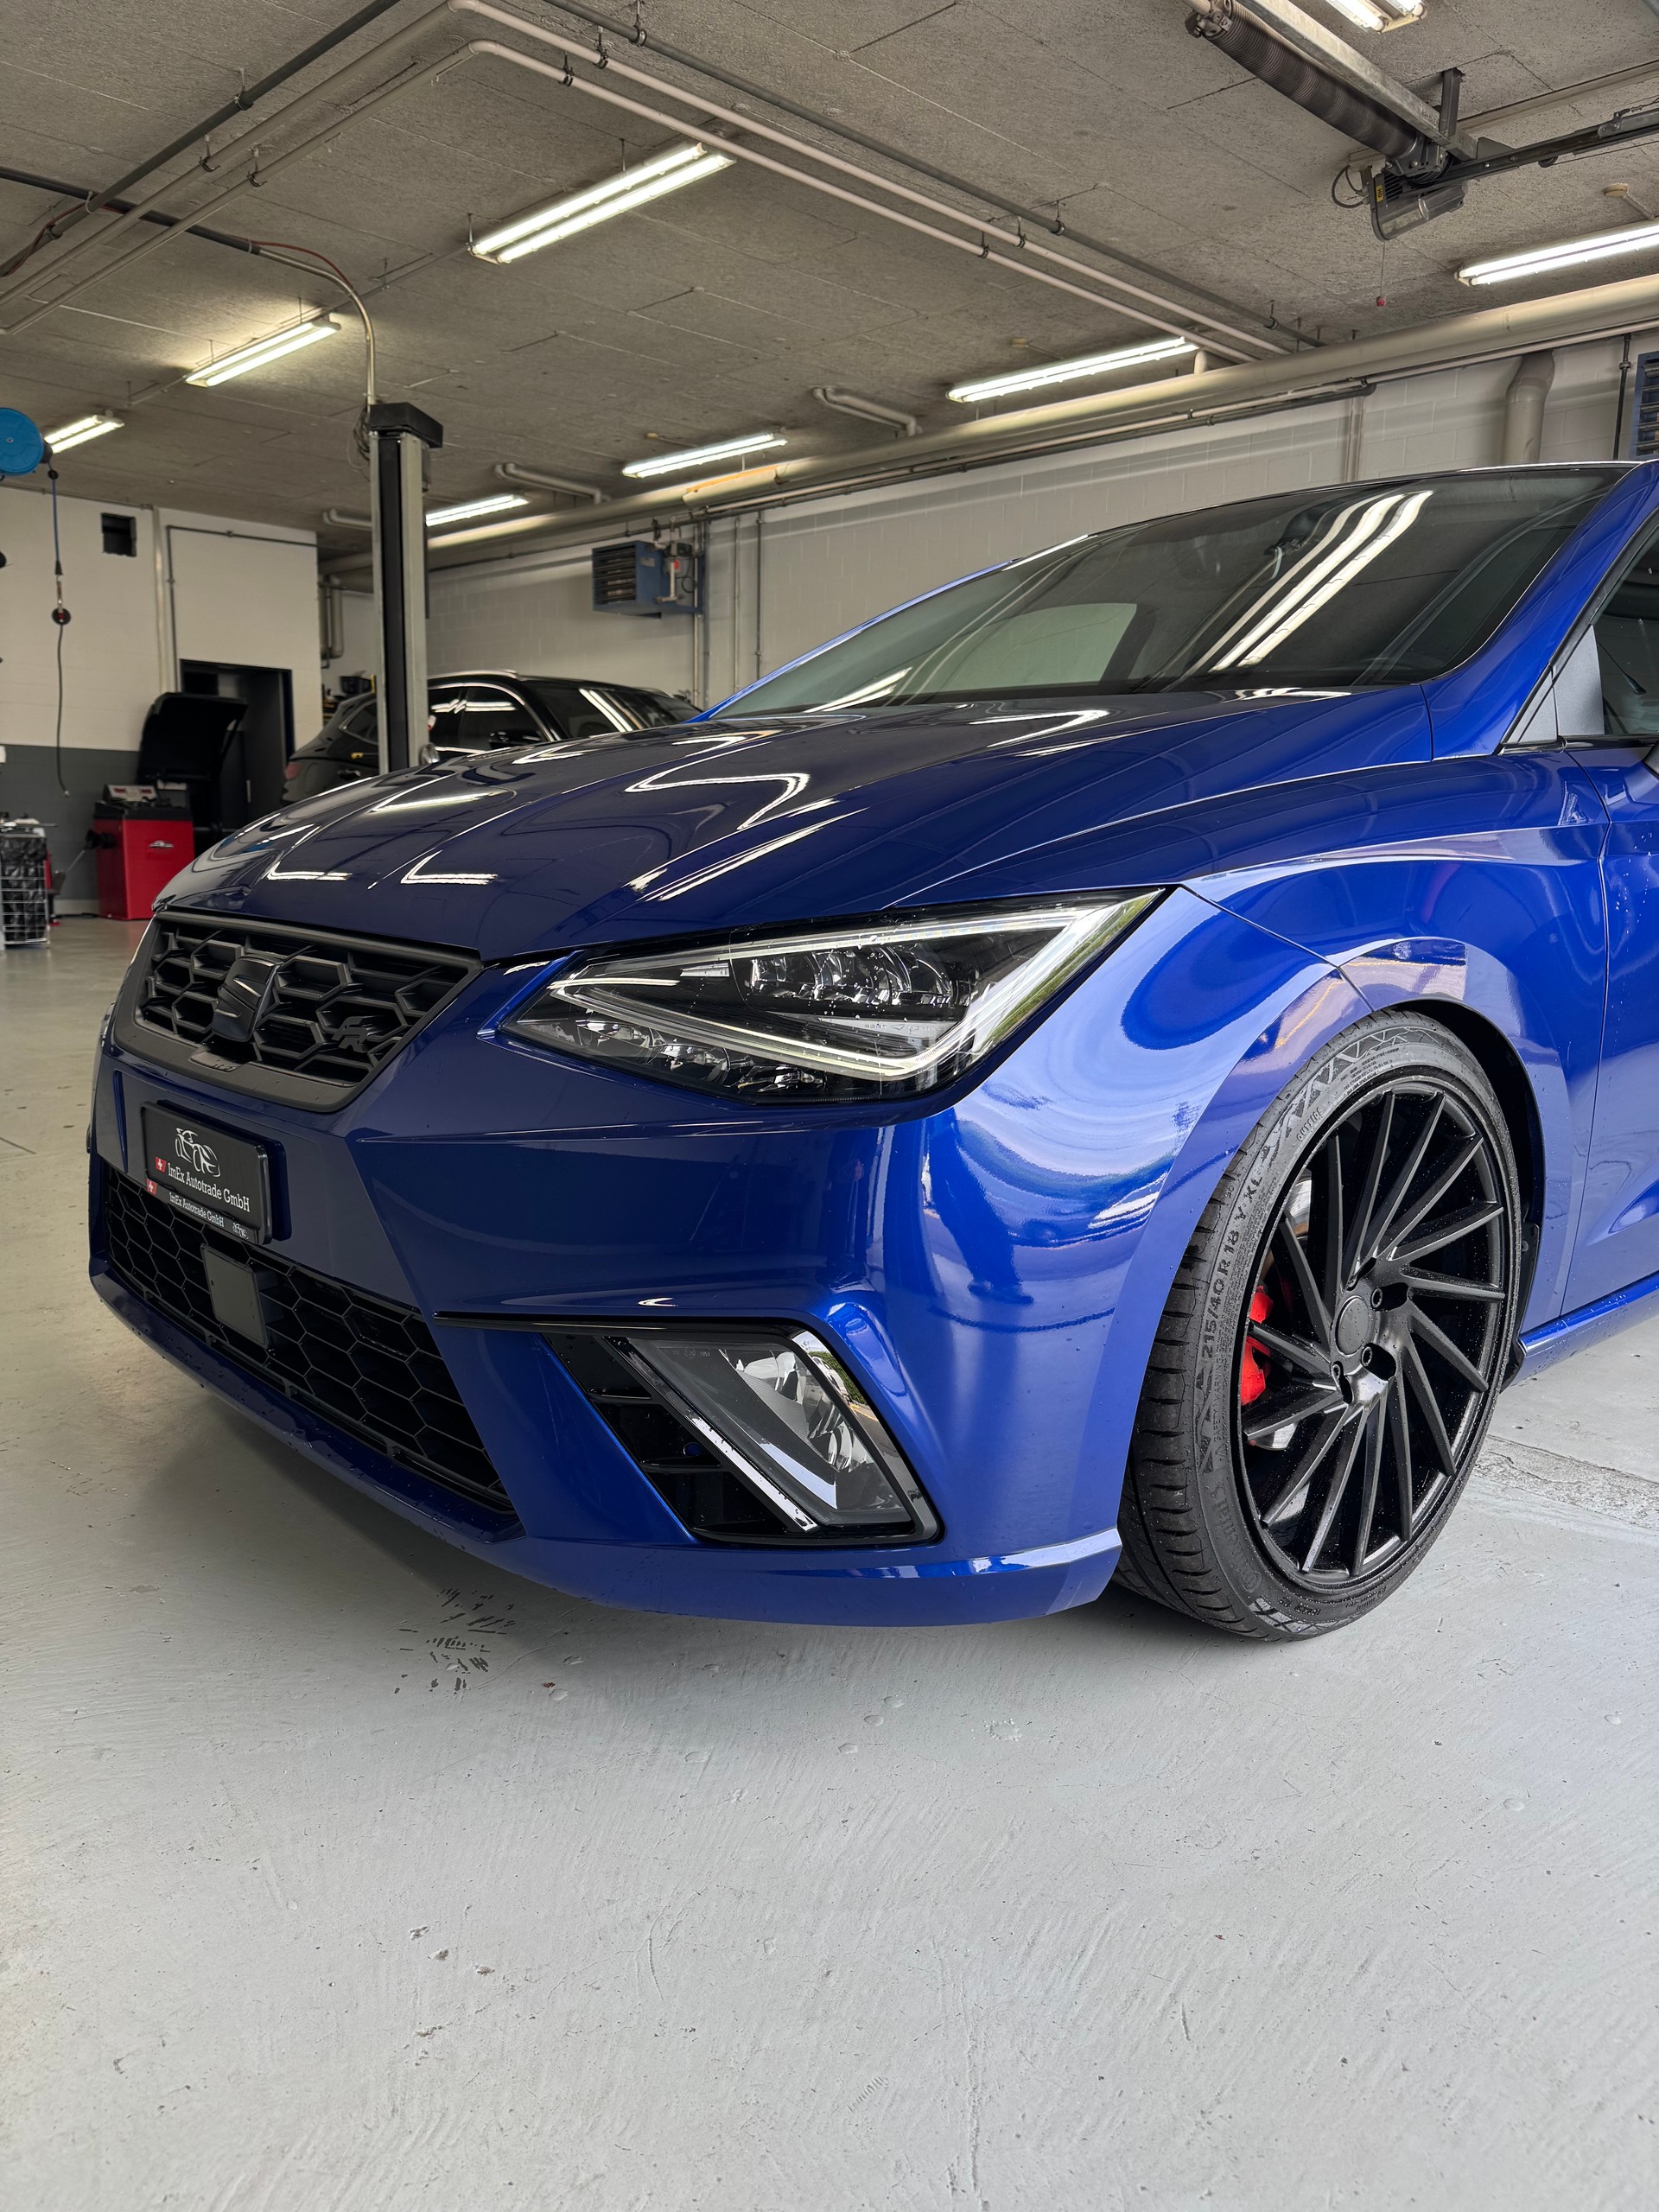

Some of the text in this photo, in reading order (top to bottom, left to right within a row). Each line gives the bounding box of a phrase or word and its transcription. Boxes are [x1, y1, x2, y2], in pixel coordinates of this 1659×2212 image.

[168, 1163, 251, 1212] ImEx Autotrade GmbH
[169, 1192, 225, 1227] ImEx Autotrade GmbH
[1201, 1279, 1225, 1359] 215/40
[1243, 1176, 1262, 1204] XL
